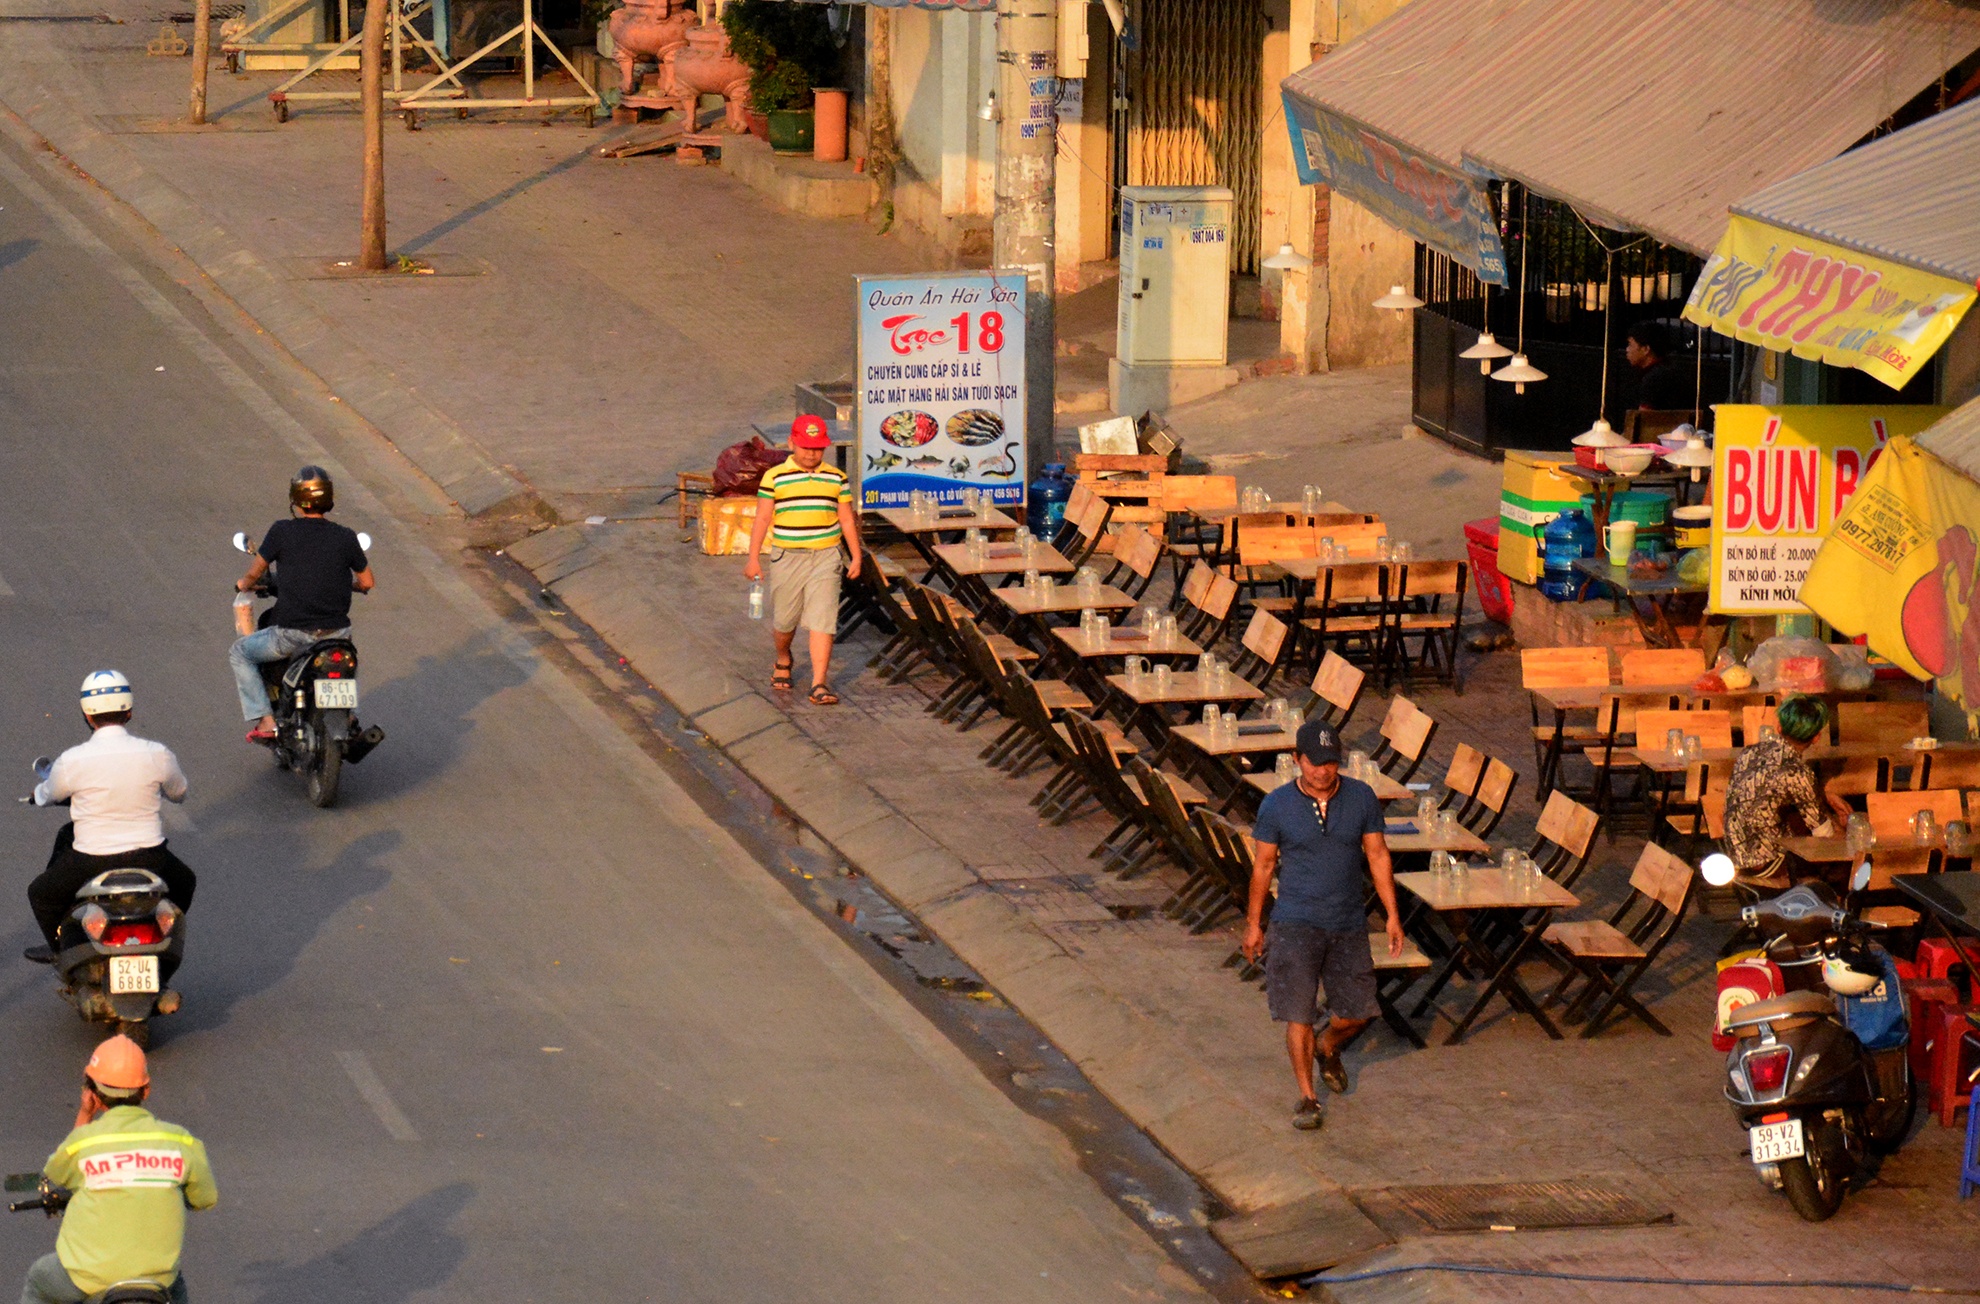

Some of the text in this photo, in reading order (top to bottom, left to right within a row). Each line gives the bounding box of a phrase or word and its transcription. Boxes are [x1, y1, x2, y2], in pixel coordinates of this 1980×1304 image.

[868, 286, 1018, 310] Quán Ăn Hải Sản
[881, 311, 1005, 355] Trọc 18
[867, 362, 902, 380] CHUYÊN
[905, 364, 928, 379] CUNG
[931, 359, 948, 378] CẤP
[962, 363, 968, 377] &
[867, 386, 885, 404] CÁC
[888, 386, 906, 406] MẶT
[909, 385, 932, 402] HÀNG
[935, 383, 949, 401] HẢI
[952, 383, 969, 401] SẢN
[972, 384, 991, 400] TƯƠI
[1726, 419, 1817, 530] BÚN
[865, 490, 879, 504] 201
[1727, 544, 1743, 560] BÚN
[1745, 545, 1758, 560] BÒ
[1760, 543, 1777, 560] HUẾ
[1728, 566, 1745, 582] BÚN
[1747, 566, 1759, 582] BÒ
[1761, 566, 1777, 582] GIÒ
[1740, 584, 1769, 601] KÍNH
[321, 682, 350, 694] 86-C1
[118, 959, 151, 974] 52-U4
[118, 975, 151, 989] 6886
[1758, 1123, 1794, 1143] 59-V2
[1755, 1139, 1800, 1160] 313.34
[85, 1152, 184, 1178] An Phong
